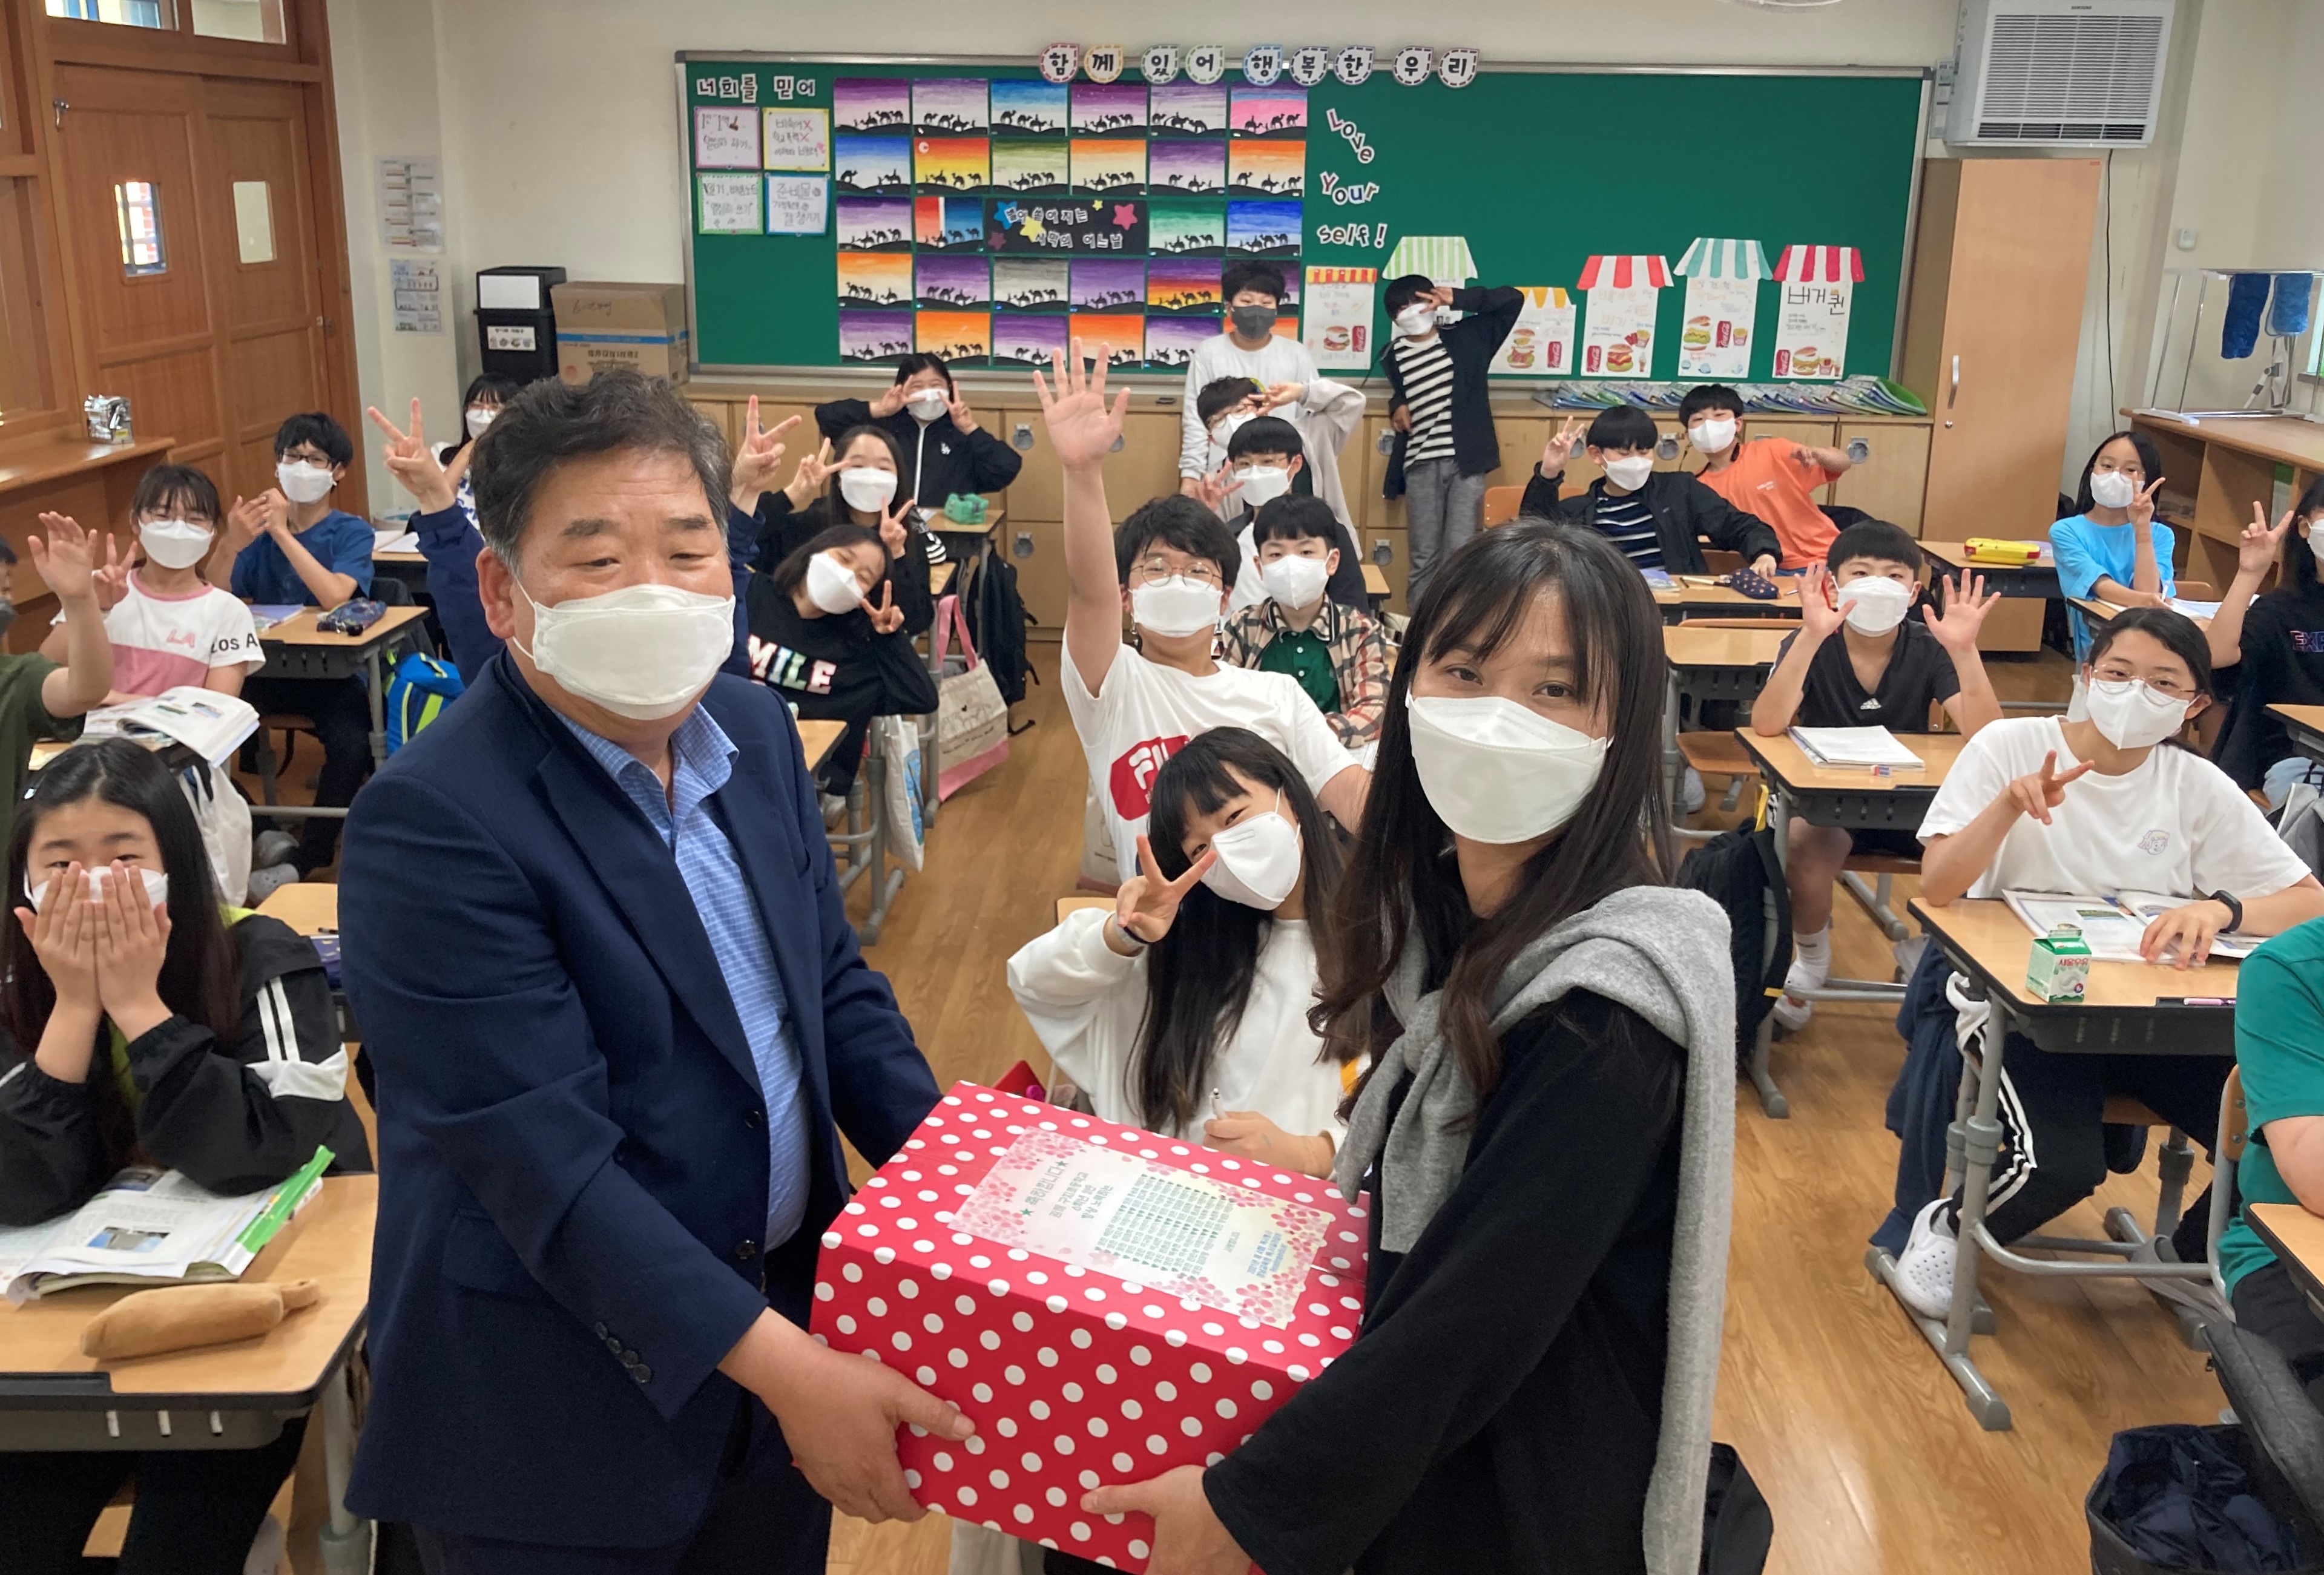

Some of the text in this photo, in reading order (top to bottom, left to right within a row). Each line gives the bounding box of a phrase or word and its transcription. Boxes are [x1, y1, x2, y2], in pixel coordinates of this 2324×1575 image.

[1050, 53, 1467, 78] 함께 있어 행복한 우리
[699, 77, 814, 100] 너희를 믿어
[1329, 111, 1372, 162] Love
[1322, 174, 1377, 203] Your
[1036, 231, 1073, 248] 사막의
[1788, 286, 1845, 315] 버거퀸
[1022, 1165, 1065, 1207] 축하합니다
